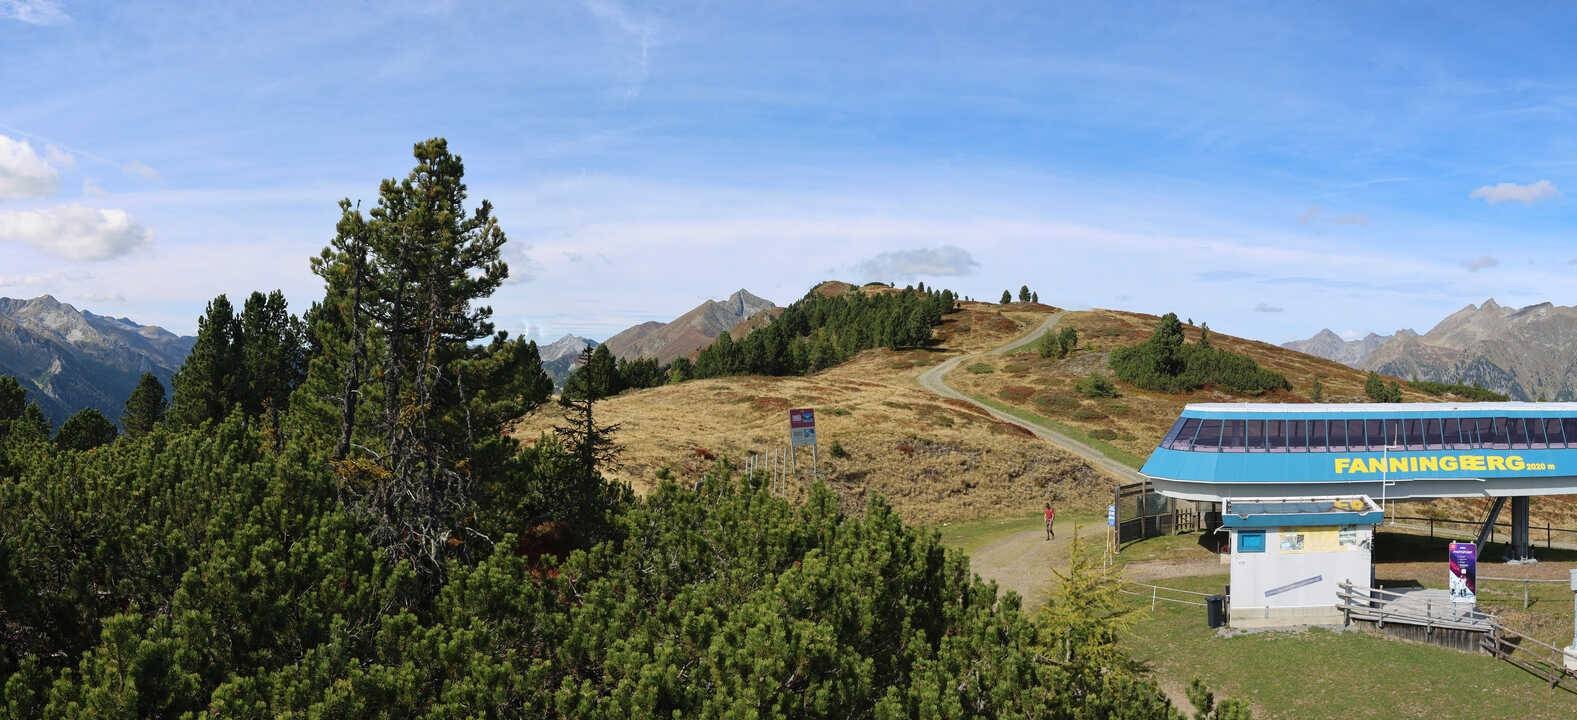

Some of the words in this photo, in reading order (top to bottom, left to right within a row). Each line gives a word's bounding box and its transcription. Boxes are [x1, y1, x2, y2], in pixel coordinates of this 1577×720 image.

[1335, 455, 1526, 474] FANNINGBERG
[1526, 463, 1546, 471] 2020
[1547, 463, 1556, 471] m
